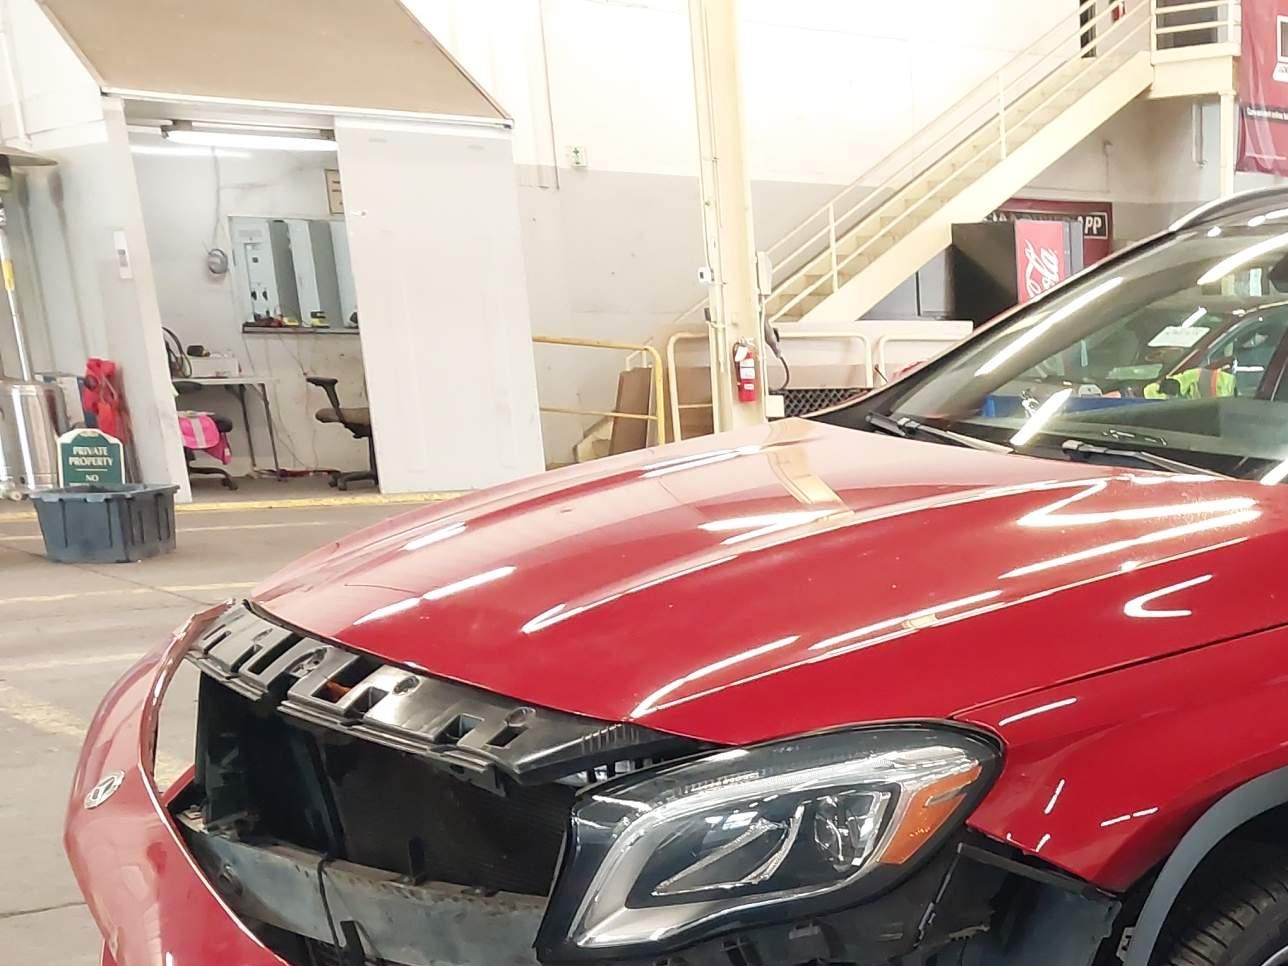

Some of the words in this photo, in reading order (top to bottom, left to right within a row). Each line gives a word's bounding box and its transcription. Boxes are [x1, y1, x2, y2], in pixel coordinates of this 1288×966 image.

[72, 446, 108, 456] PRIVATE
[68, 456, 113, 466] PROPERTY
[85, 474, 99, 482] NO
